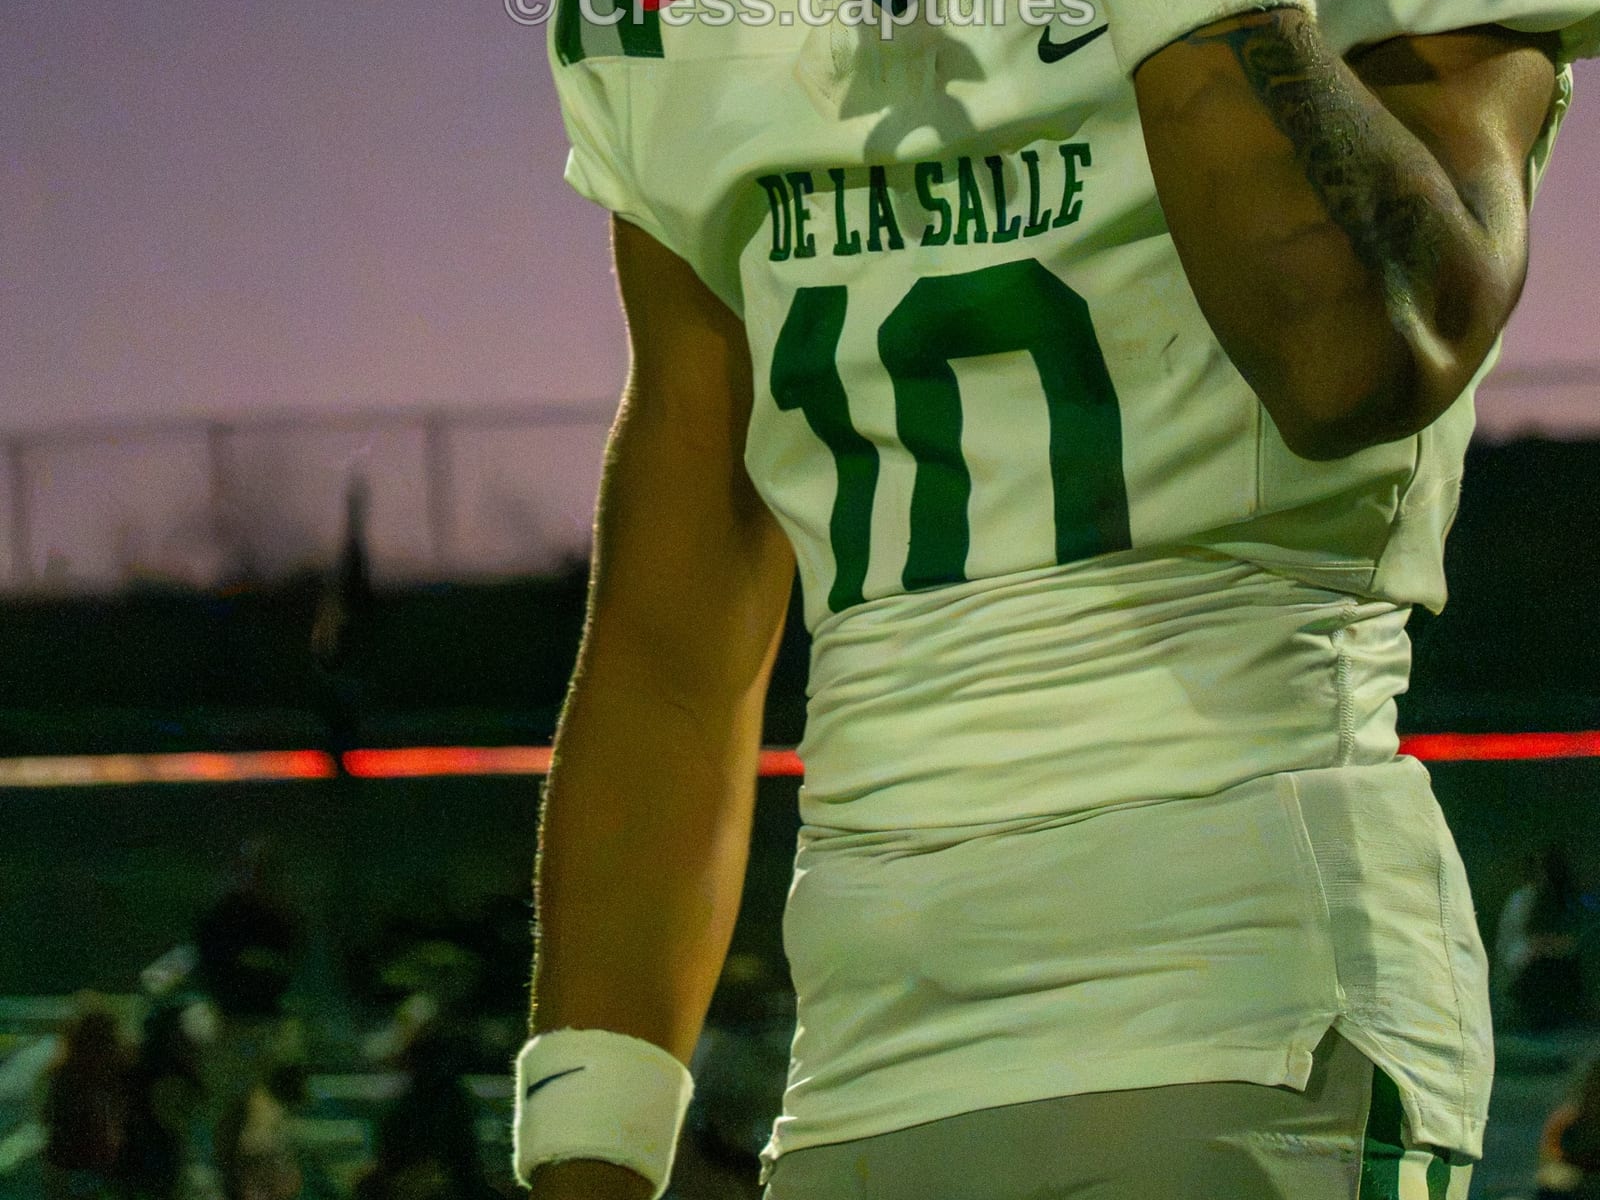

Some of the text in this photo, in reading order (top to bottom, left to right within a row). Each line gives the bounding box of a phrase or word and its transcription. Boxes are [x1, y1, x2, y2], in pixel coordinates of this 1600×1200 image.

[756, 142, 1092, 262] DE LA SALLE
[770, 257, 1132, 614] 10
